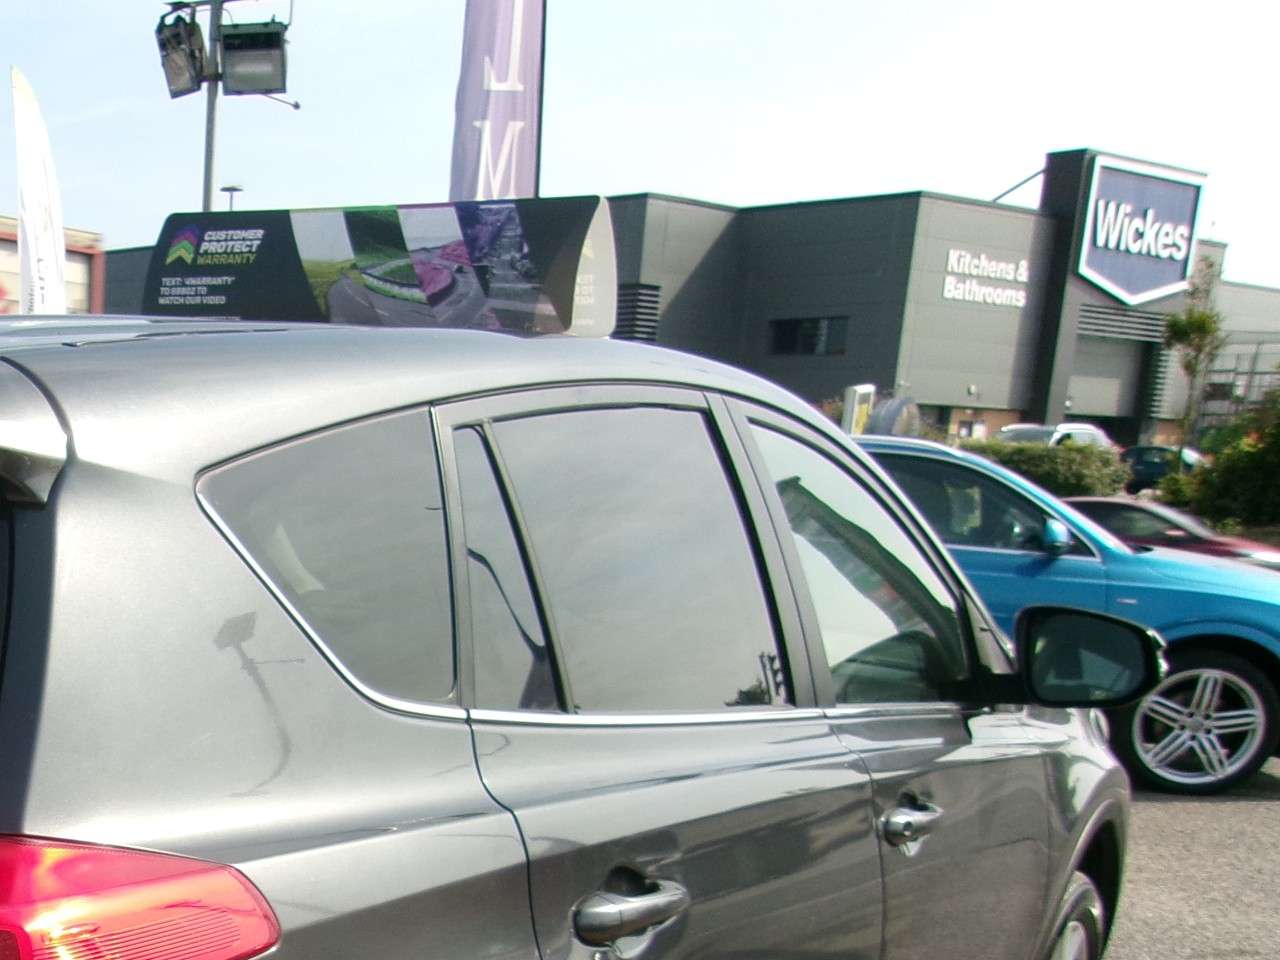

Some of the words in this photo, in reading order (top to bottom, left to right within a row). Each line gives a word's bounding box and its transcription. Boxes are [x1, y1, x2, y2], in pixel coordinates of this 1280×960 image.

[204, 229, 264, 241] CUSTOMER
[1094, 199, 1188, 261] Wickes
[199, 240, 261, 254] PROTECT
[196, 253, 256, 265] WARRANTY
[947, 248, 1017, 280] Kitchens
[1016, 259, 1028, 282] &
[943, 275, 1027, 307] Bathrooms
